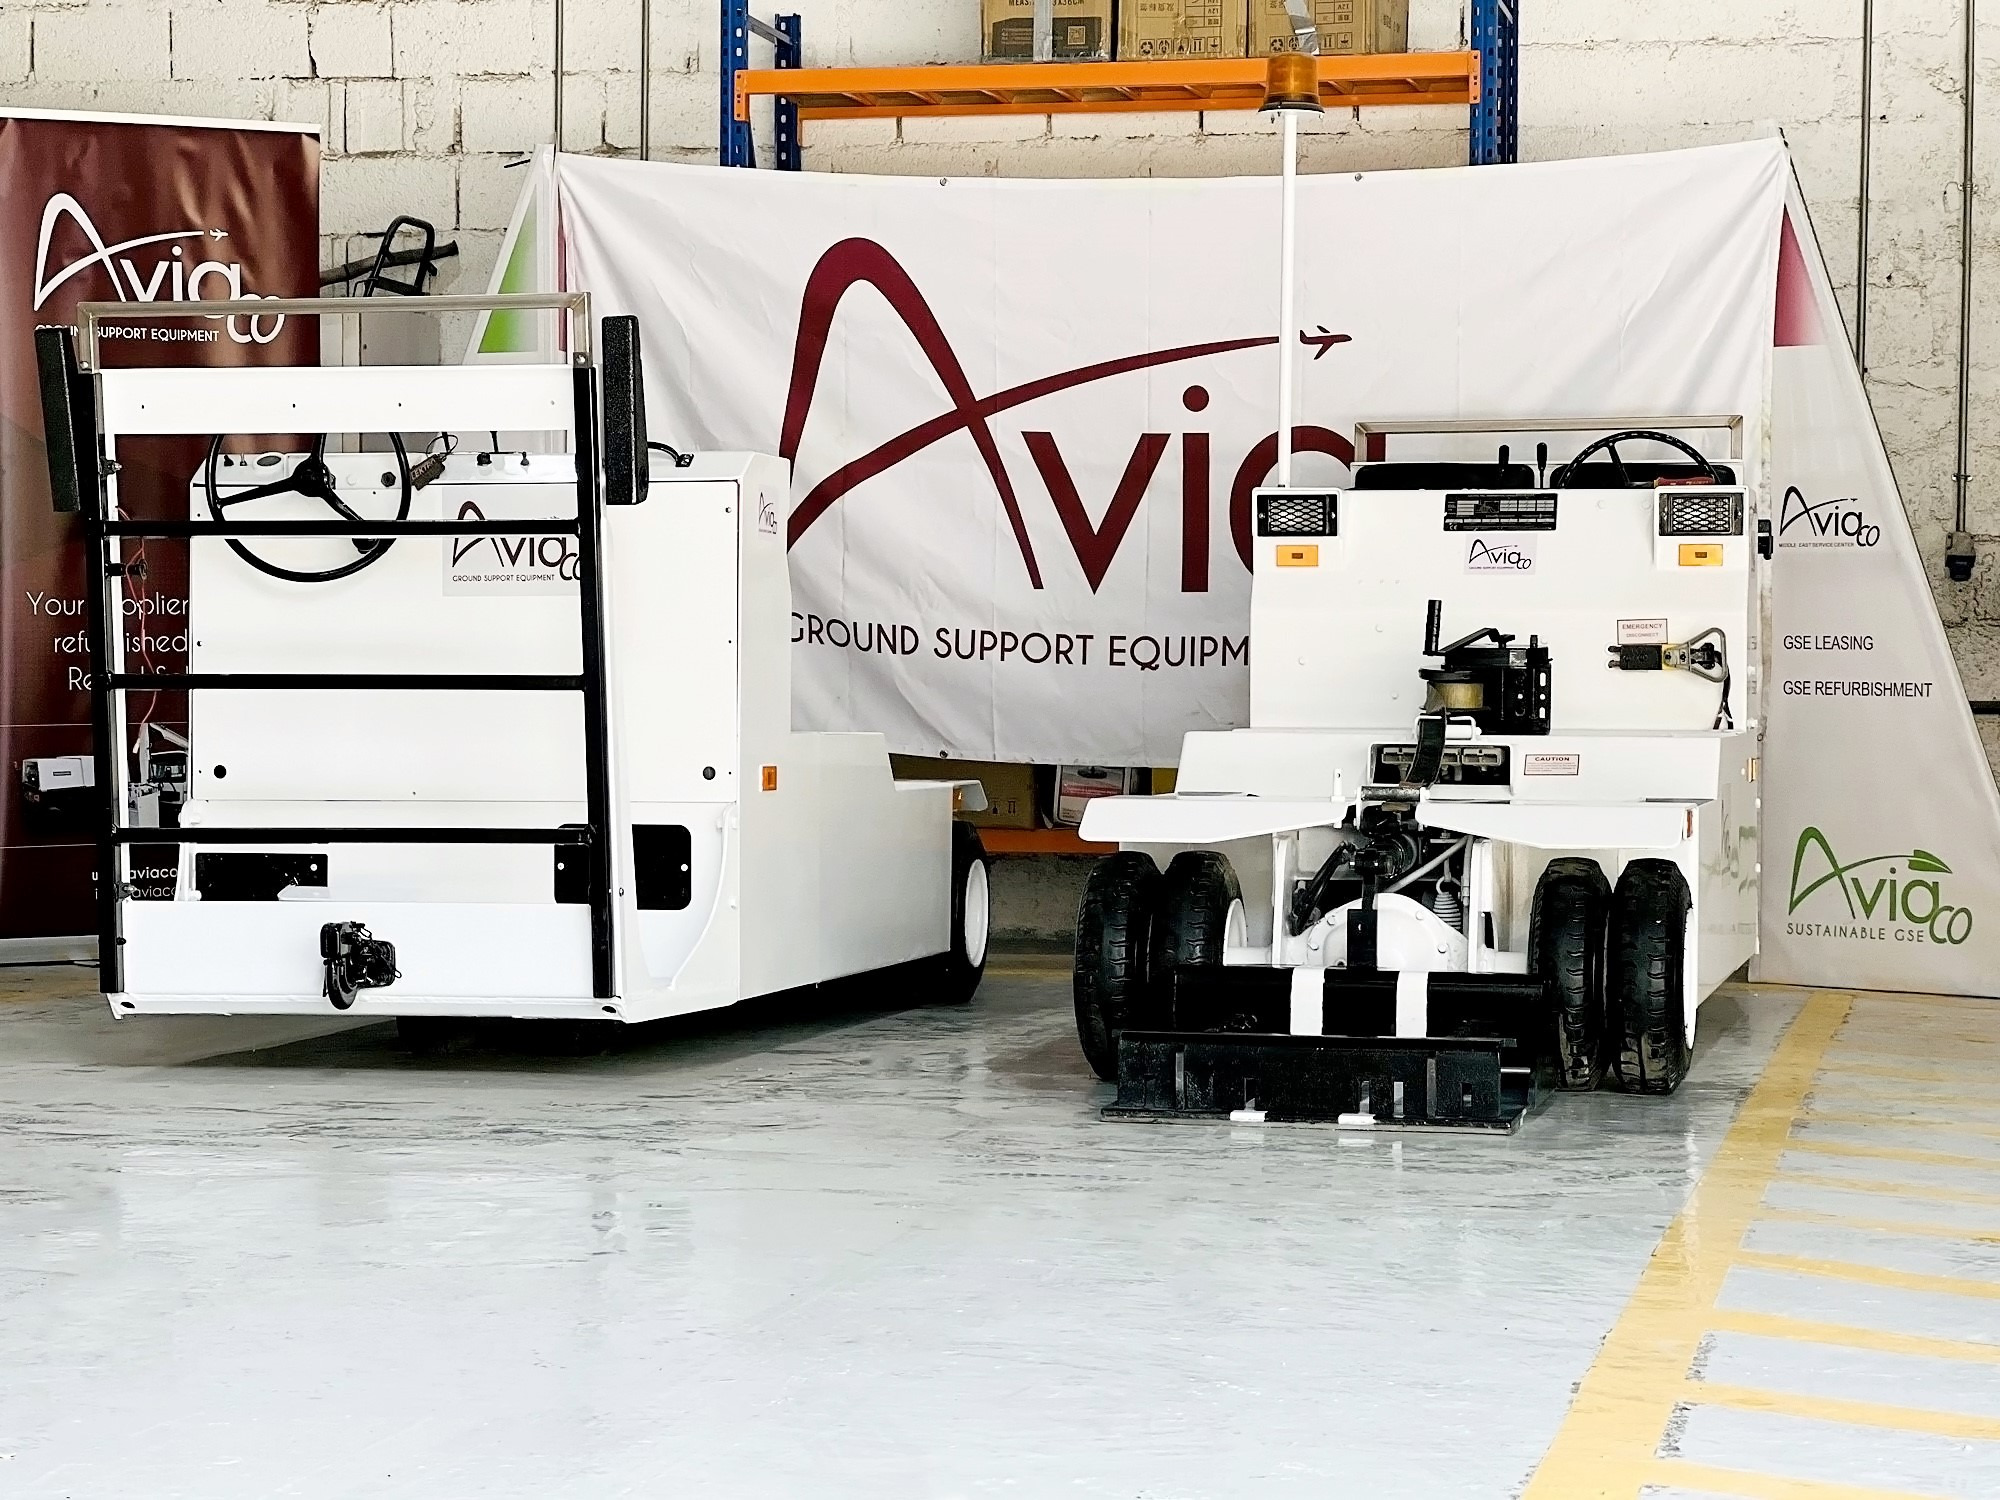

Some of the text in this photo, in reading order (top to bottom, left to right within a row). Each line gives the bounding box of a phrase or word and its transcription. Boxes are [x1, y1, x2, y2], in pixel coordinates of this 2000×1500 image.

[151, 328, 219, 342] EQUIPMENT
[452, 574, 555, 582] GROUND SUPPORT EQUIPMENT
[26, 591, 84, 615] Your
[933, 627, 1094, 665] SUPPORT
[1783, 635, 1874, 651] GSE LEASING
[1783, 680, 1932, 698] GSE REFURBISHMENT
[1786, 922, 1924, 943] SUSTAINABLE GSE
